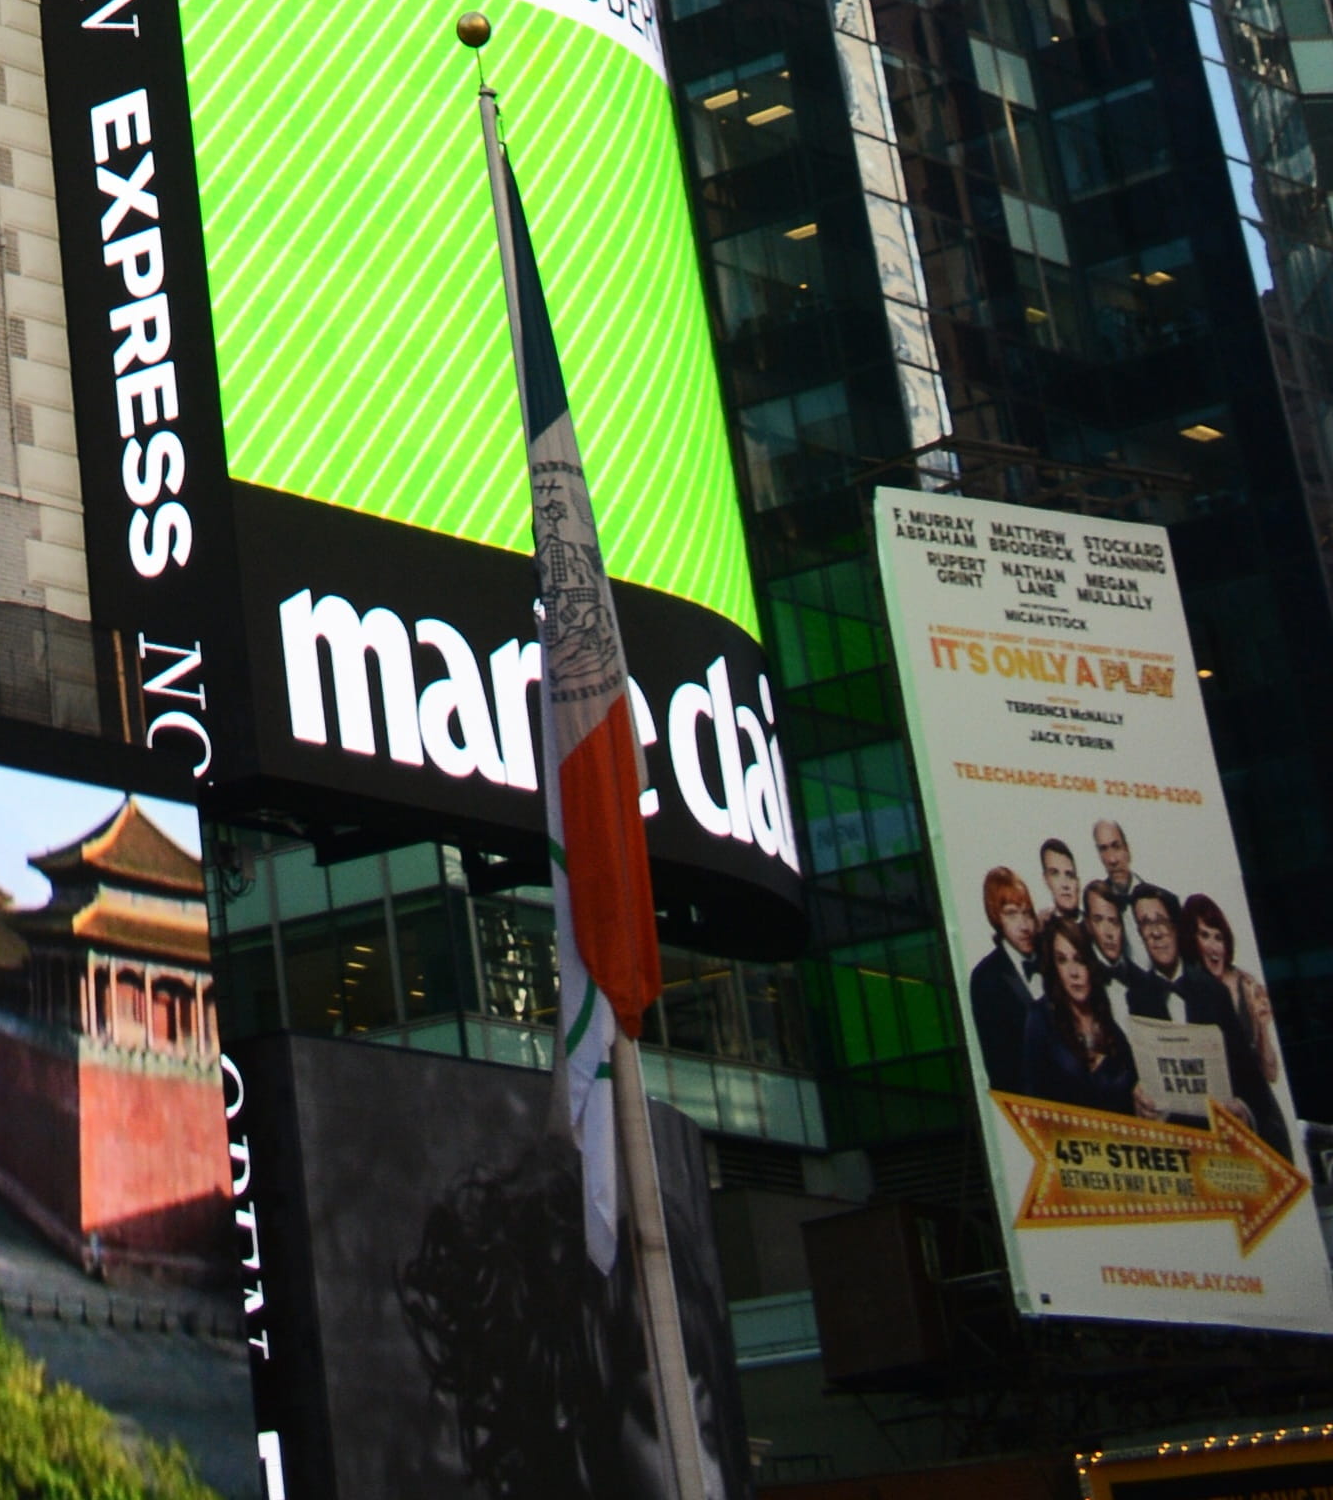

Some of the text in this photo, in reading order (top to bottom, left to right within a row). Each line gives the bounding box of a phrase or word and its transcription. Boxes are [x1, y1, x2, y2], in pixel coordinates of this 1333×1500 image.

[89, 89, 193, 579] EXPRESS
[909, 510, 975, 532] MURRAY
[895, 523, 978, 548] ABRAHAM
[990, 522, 1066, 546] MATTHEW
[989, 538, 1076, 563] BRODERICK
[1083, 535, 1164, 559] STOCKARD
[927, 552, 987, 573] RUPERT
[1001, 561, 1067, 584] NATHAN
[1088, 552, 1167, 575] CHANNING
[937, 568, 984, 589] GRINT
[1017, 580, 1058, 599] LANE
[1084, 573, 1139, 593] MEGAN
[1076, 587, 1154, 611] MULLALLY
[1004, 609, 1088, 632] MICAH STOCK
[929, 637, 989, 676] IT'S
[992, 645, 1067, 685] ONLY
[1076, 655, 1098, 689] A
[1099, 658, 1176, 698] PLAY
[136, 630, 214, 787] NO
[279, 588, 659, 818] mar
[1006, 699, 1069, 719] TERRENCE
[1030, 730, 1063, 745] JACK
[953, 761, 1099, 793] TELECHARGE.COM
[1176, 1077, 1207, 1094] PLAY
[1055, 1139, 1192, 1173] 45TH STREET
[1100, 1264, 1265, 1296] ITSONLYAPLAY.COM
